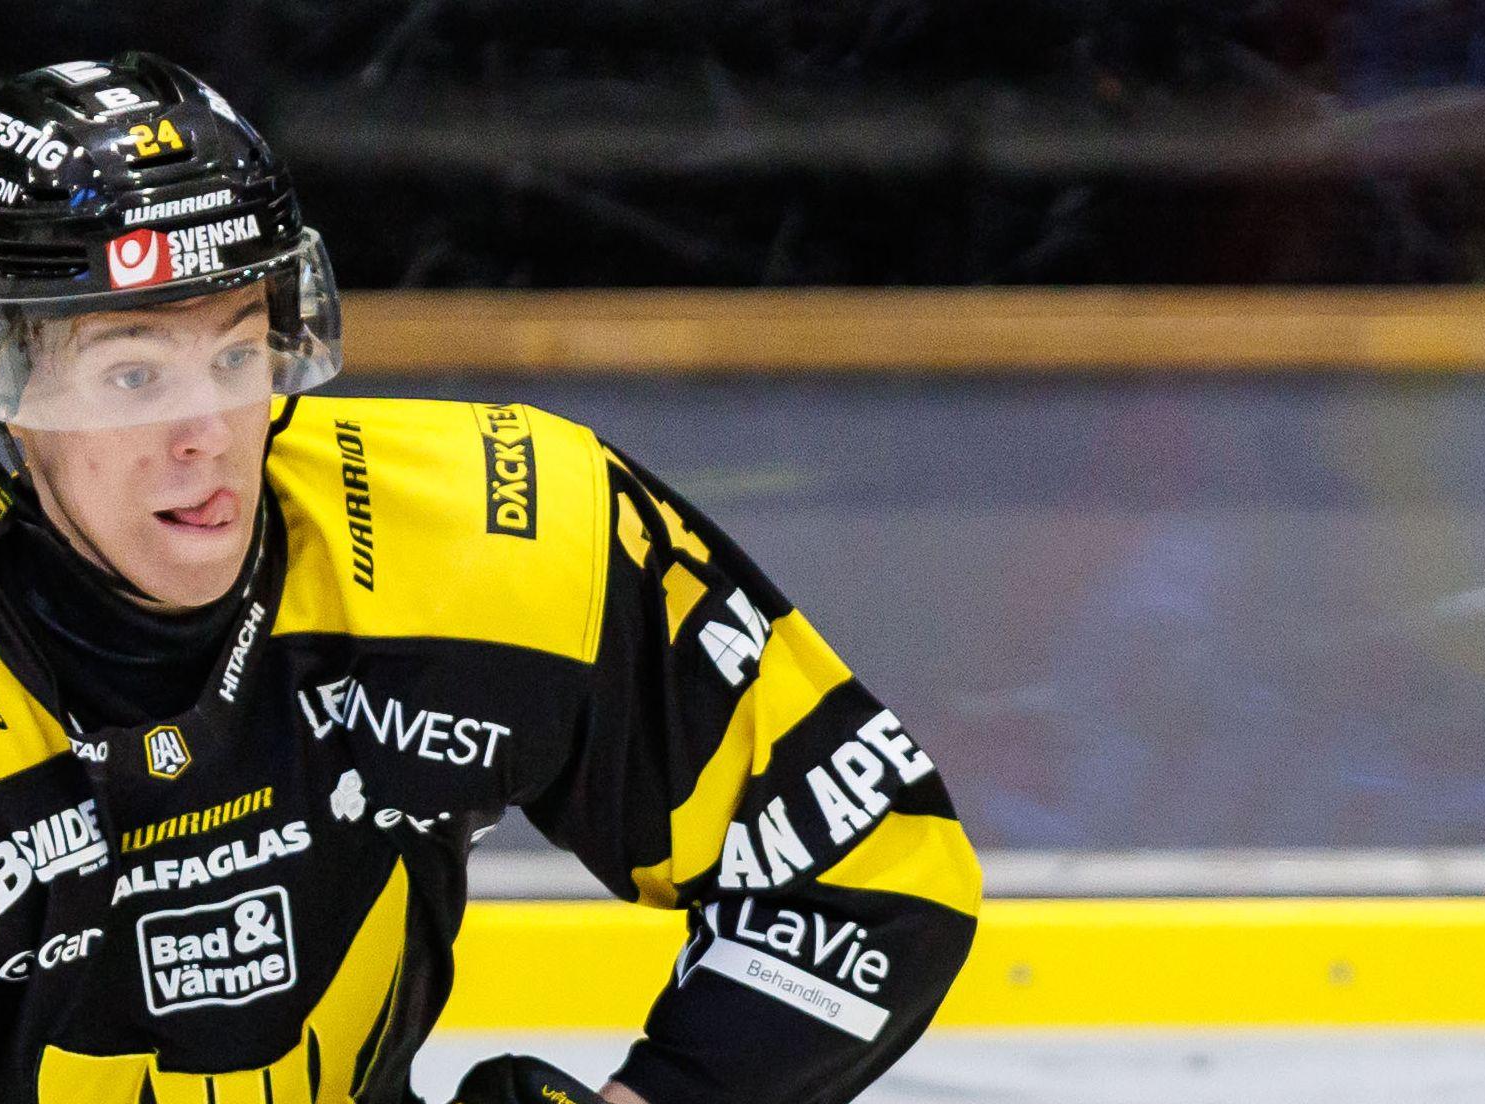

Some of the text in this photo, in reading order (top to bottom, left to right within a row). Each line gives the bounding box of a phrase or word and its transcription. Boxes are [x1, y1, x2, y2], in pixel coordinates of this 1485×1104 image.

[128, 119, 185, 157] 24
[124, 189, 233, 226] WARRIOR
[167, 214, 262, 256] SVENSKA
[171, 246, 225, 280] SPEL
[492, 441, 529, 530] DÄCK
[218, 601, 266, 702] HITACHI
[121, 787, 273, 853] WARRIOR
[718, 796, 814, 889] AN
[111, 820, 312, 906] ALFAGLAS
[150, 899, 283, 967] Bad &
[734, 896, 890, 993] LaVie
[153, 953, 287, 1001] Värme
[746, 958, 842, 1019] Behandling
